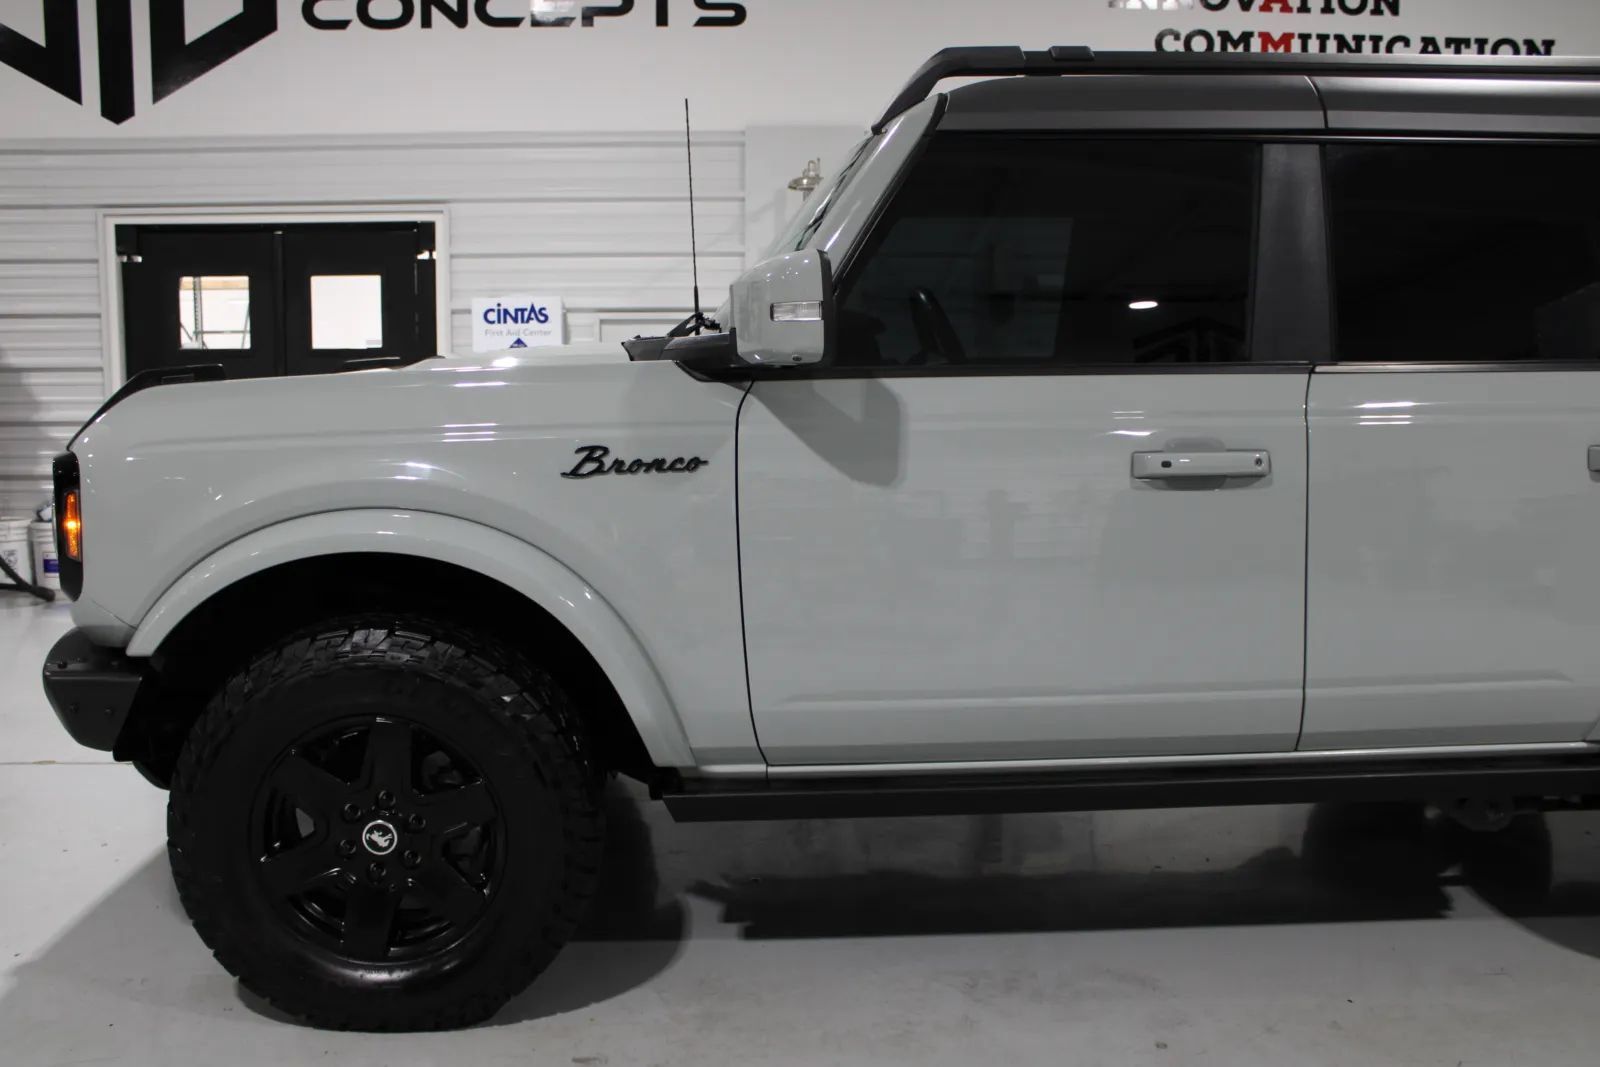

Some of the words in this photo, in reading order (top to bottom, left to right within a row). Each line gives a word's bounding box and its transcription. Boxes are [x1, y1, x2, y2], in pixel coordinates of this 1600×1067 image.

[1154, 28, 1556, 56] COMMUNICATION
[484, 328, 504, 337] First
[505, 328, 521, 337] Aid
[522, 328, 552, 337] Center
[560, 445, 709, 479] Bronco
